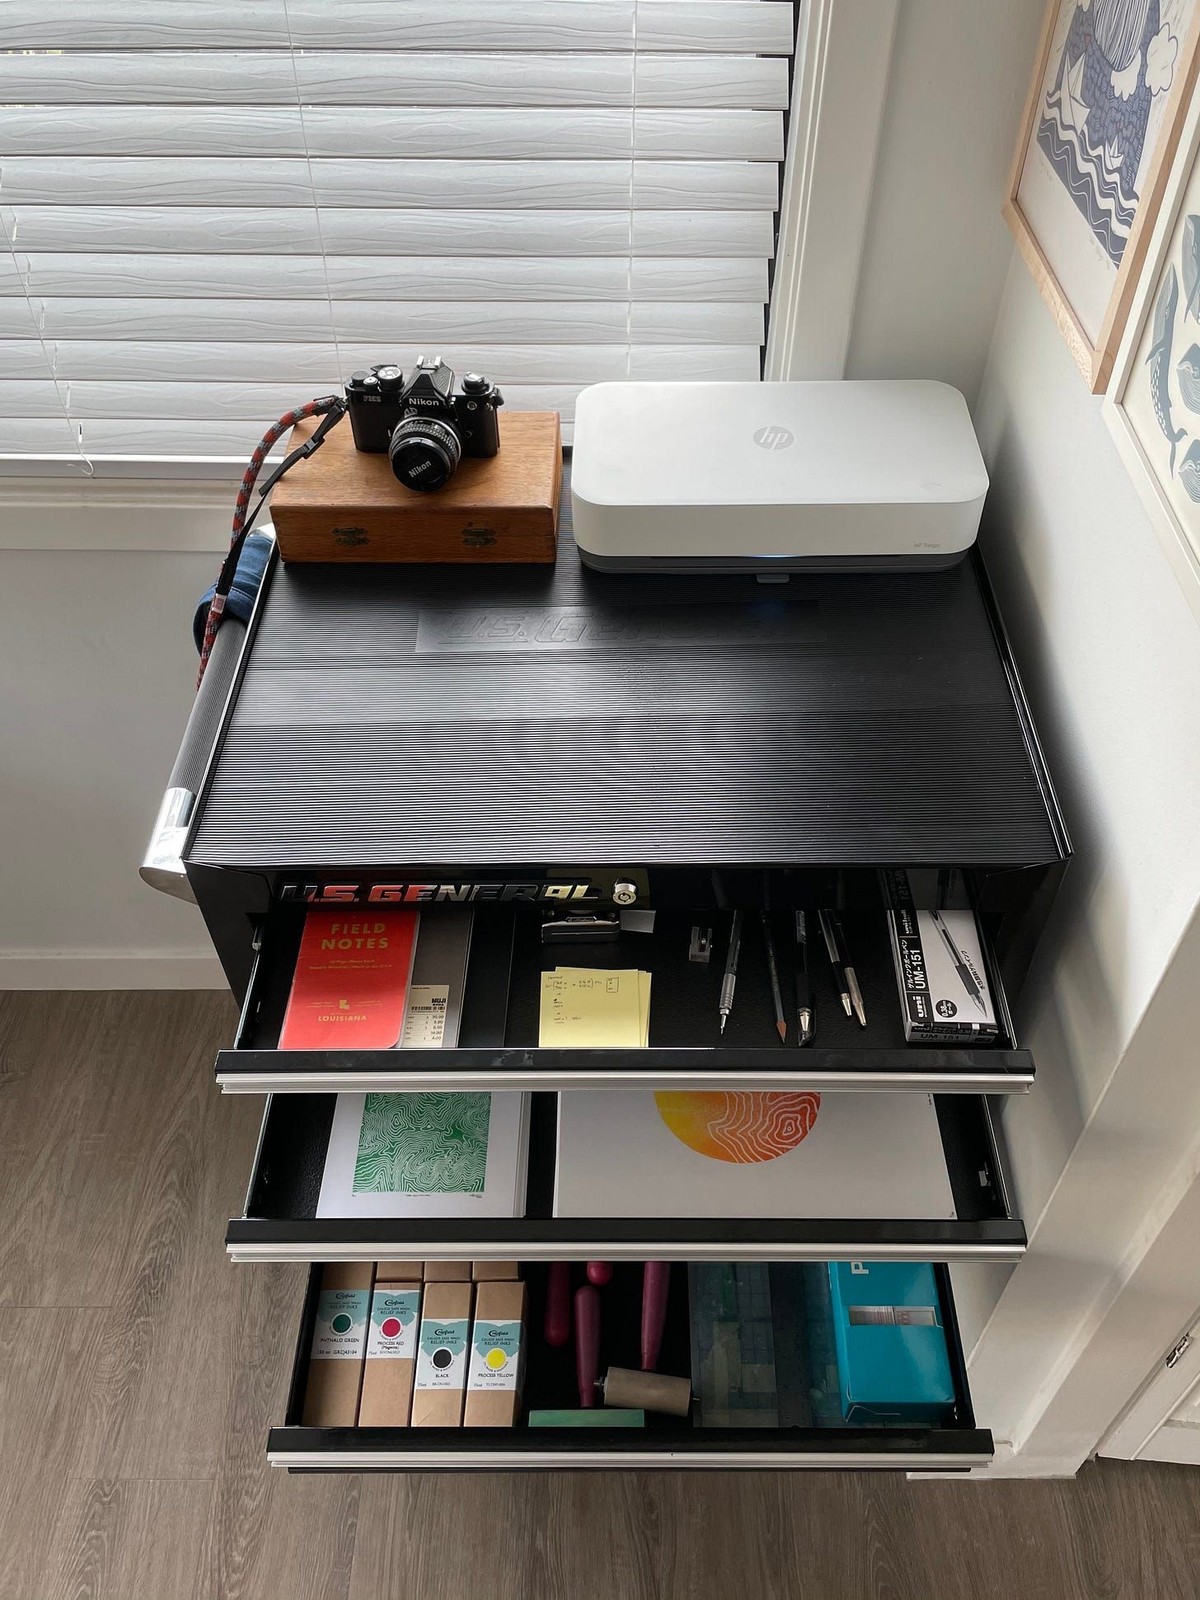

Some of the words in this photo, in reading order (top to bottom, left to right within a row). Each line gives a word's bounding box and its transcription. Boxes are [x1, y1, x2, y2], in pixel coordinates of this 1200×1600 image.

[408, 398, 440, 406] Nikon
[759, 426, 790, 450] hp
[408, 460, 432, 478] Nikon
[280, 884, 359, 902] U.S.
[367, 884, 599, 902] GENERAL
[331, 923, 386, 934] FIELD
[321, 937, 389, 950] NOTES
[910, 949, 926, 989] UM-151
[913, 995, 924, 1017] uni
